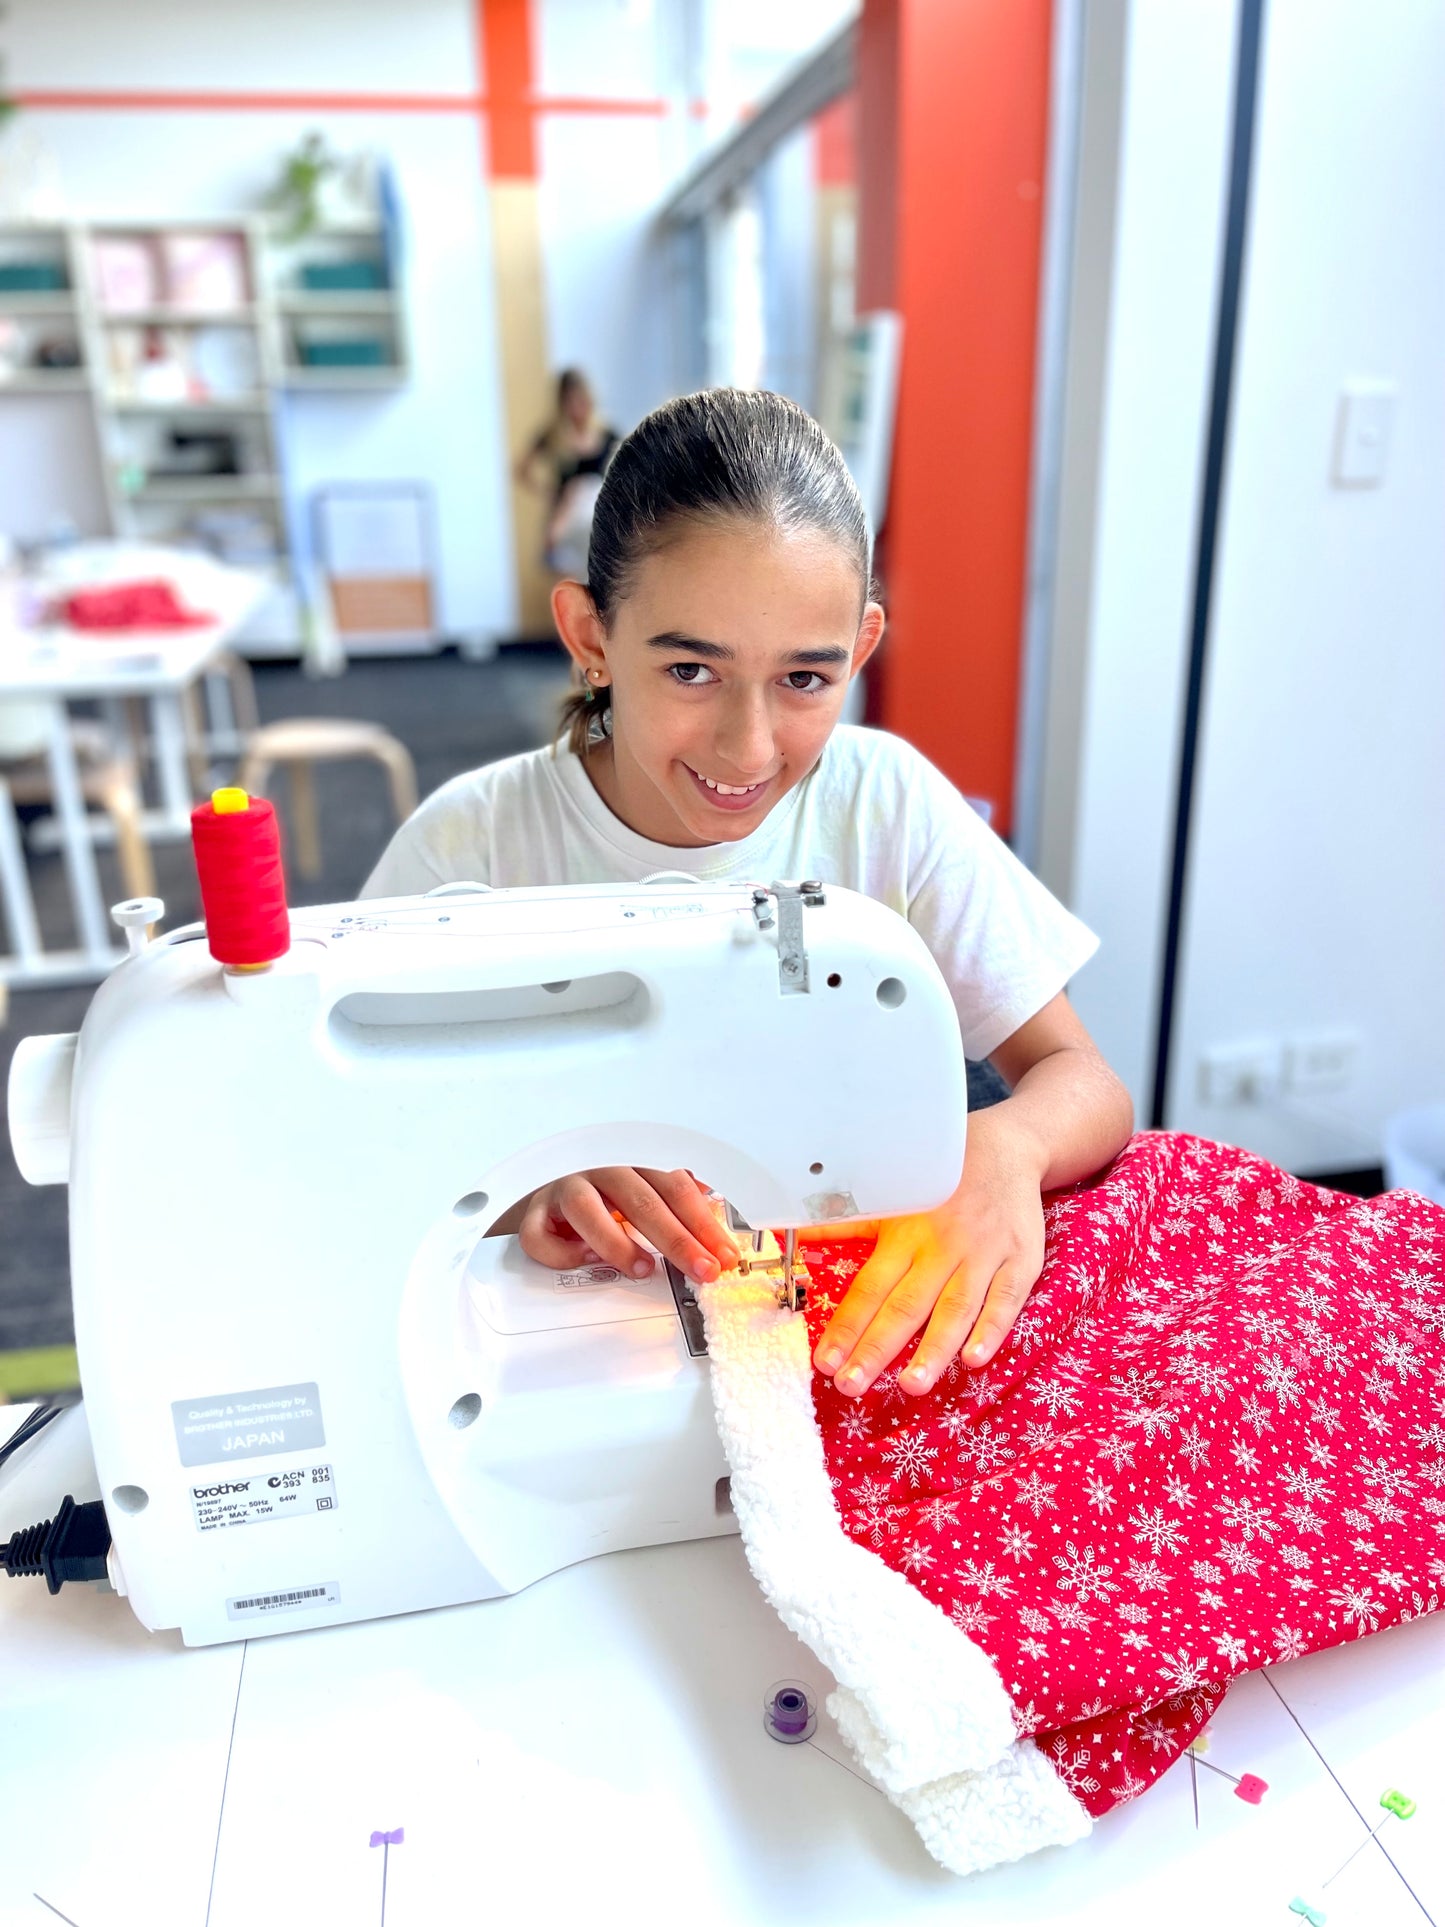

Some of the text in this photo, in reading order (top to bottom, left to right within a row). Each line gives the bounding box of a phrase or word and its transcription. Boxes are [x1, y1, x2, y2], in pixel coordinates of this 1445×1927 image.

[188, 1396, 307, 1420] Quality & Technology by
[184, 1420, 233, 1435] BROTHER
[222, 1430, 285, 1451] JAPAN
[282, 1467, 329, 1481] ACN 001
[283, 1475, 330, 1488] 393 835
[193, 1481, 251, 1499] brother
[248, 1499, 269, 1508] 50Hz
[279, 1494, 297, 1502] 64W
[199, 1514, 224, 1524] LAMP
[256, 1506, 273, 1515] 15W
[201, 1523, 217, 1531] MADE
